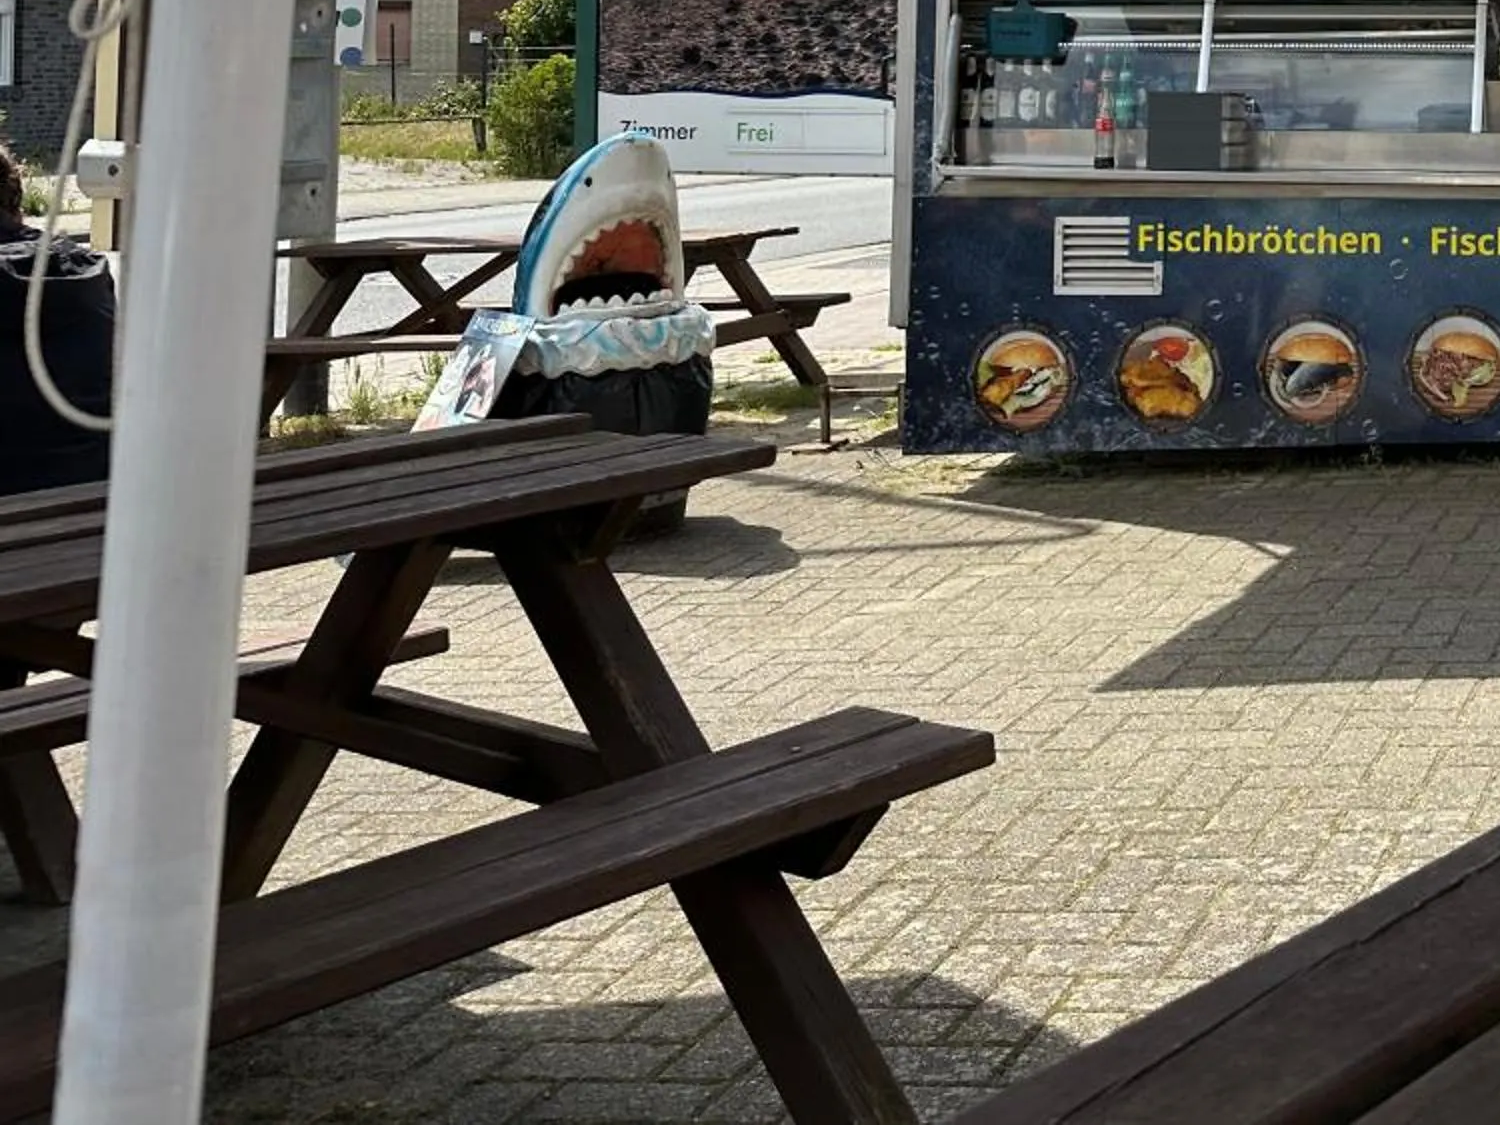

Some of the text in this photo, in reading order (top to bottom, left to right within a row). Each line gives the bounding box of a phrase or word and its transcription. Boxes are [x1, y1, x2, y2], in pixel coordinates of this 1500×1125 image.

[619, 119, 698, 140] Zimmer
[736, 122, 774, 142] Frei
[1136, 223, 1382, 255] Fischbrötchen
